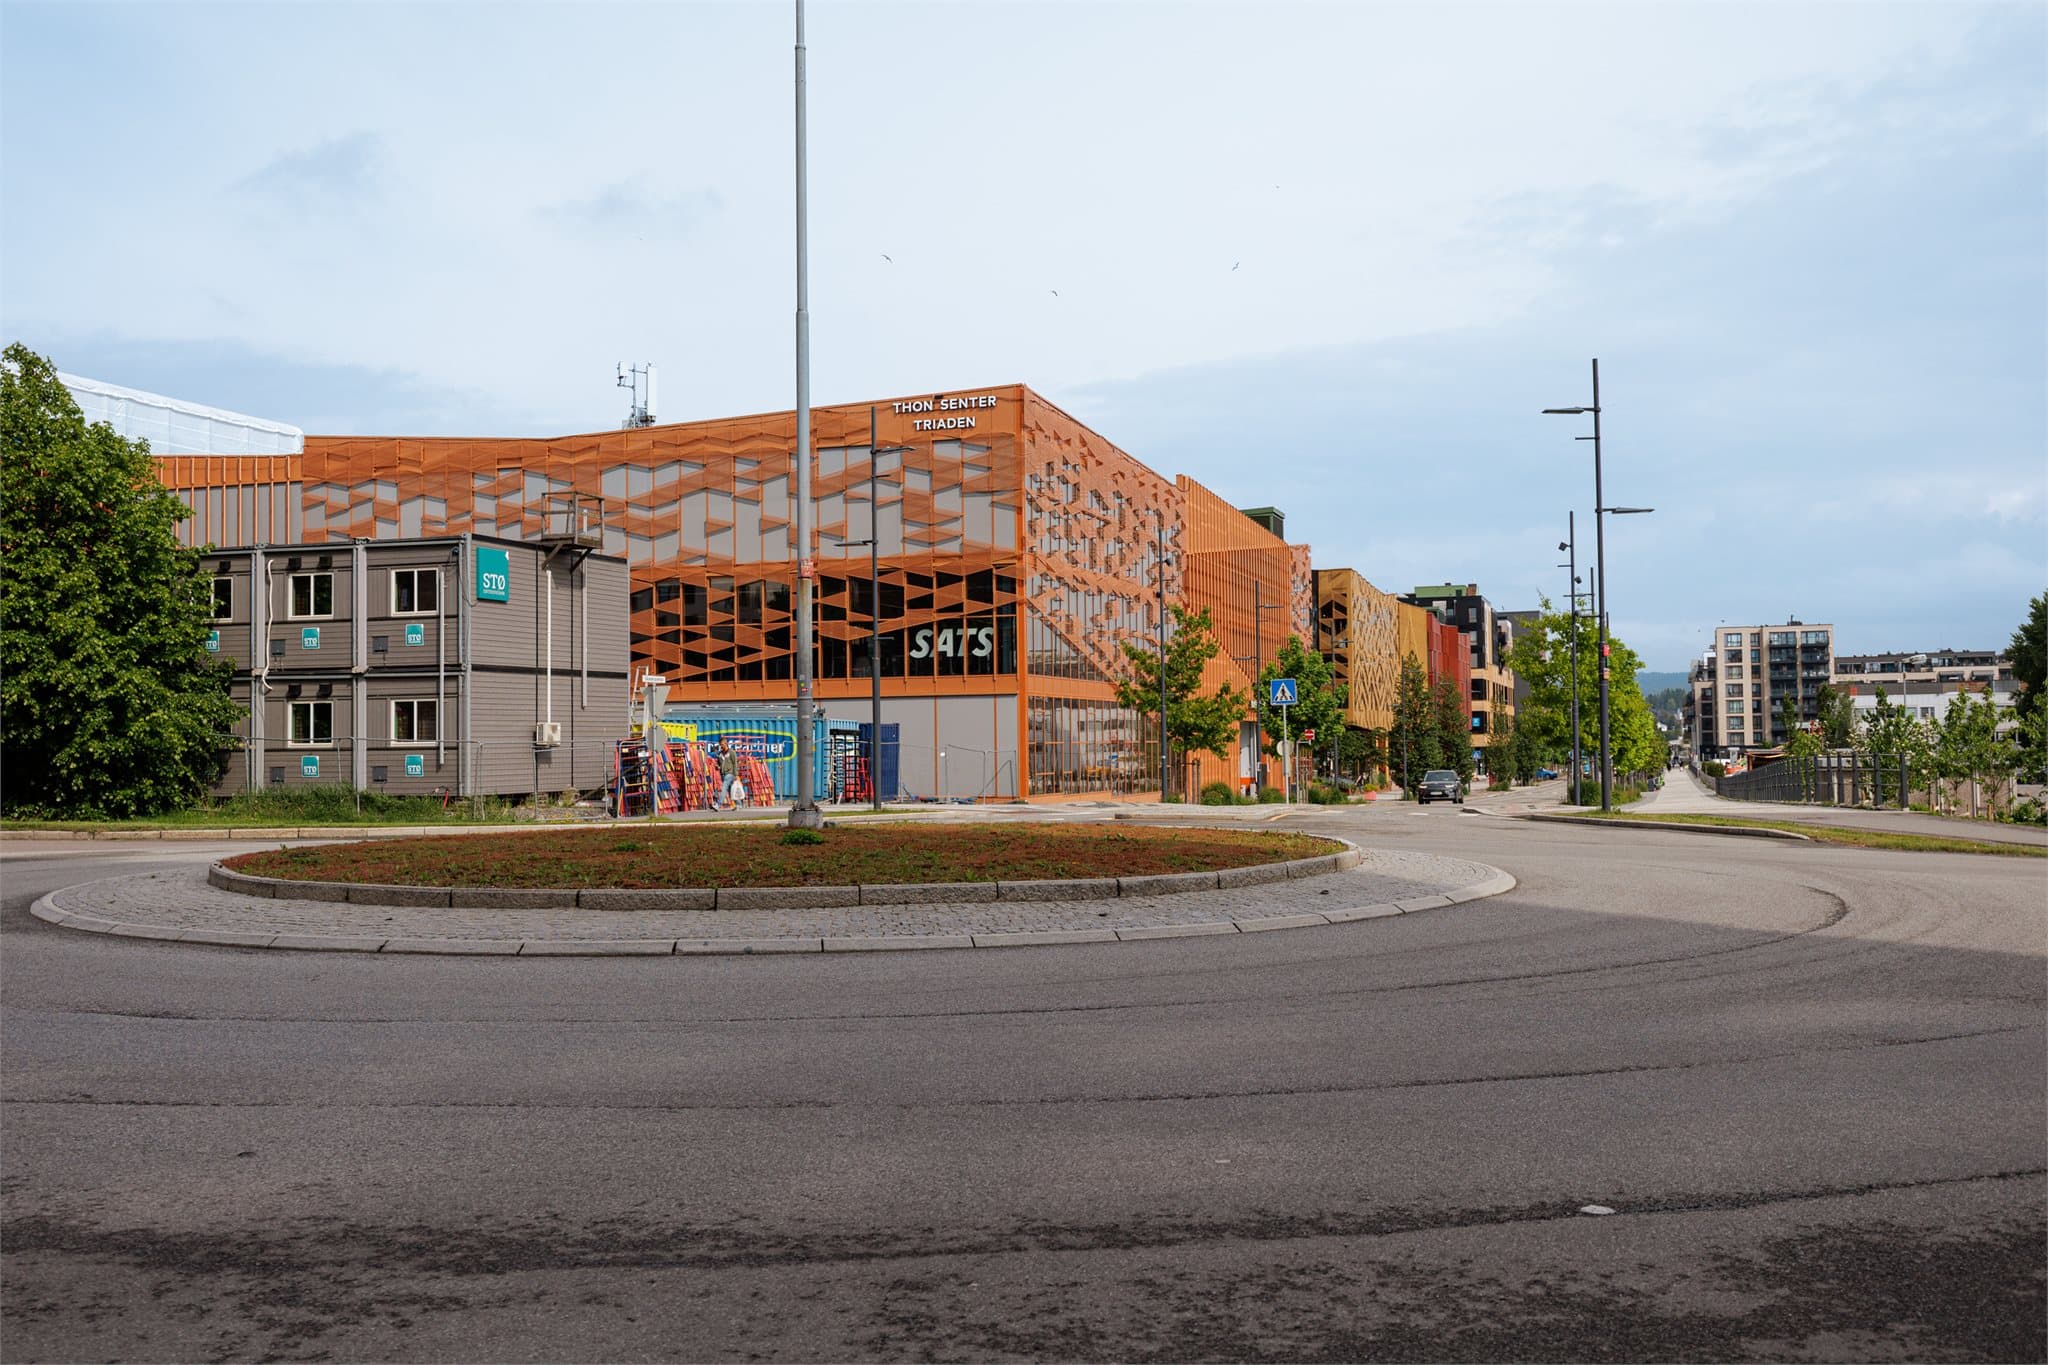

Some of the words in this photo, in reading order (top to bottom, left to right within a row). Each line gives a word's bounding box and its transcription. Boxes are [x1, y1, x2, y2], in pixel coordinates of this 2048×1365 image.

[893, 400, 933, 414] THON
[940, 396, 997, 410] SENTER
[914, 416, 976, 431] TRIADEN
[483, 573, 506, 590] STØ
[909, 627, 994, 658] SATS
